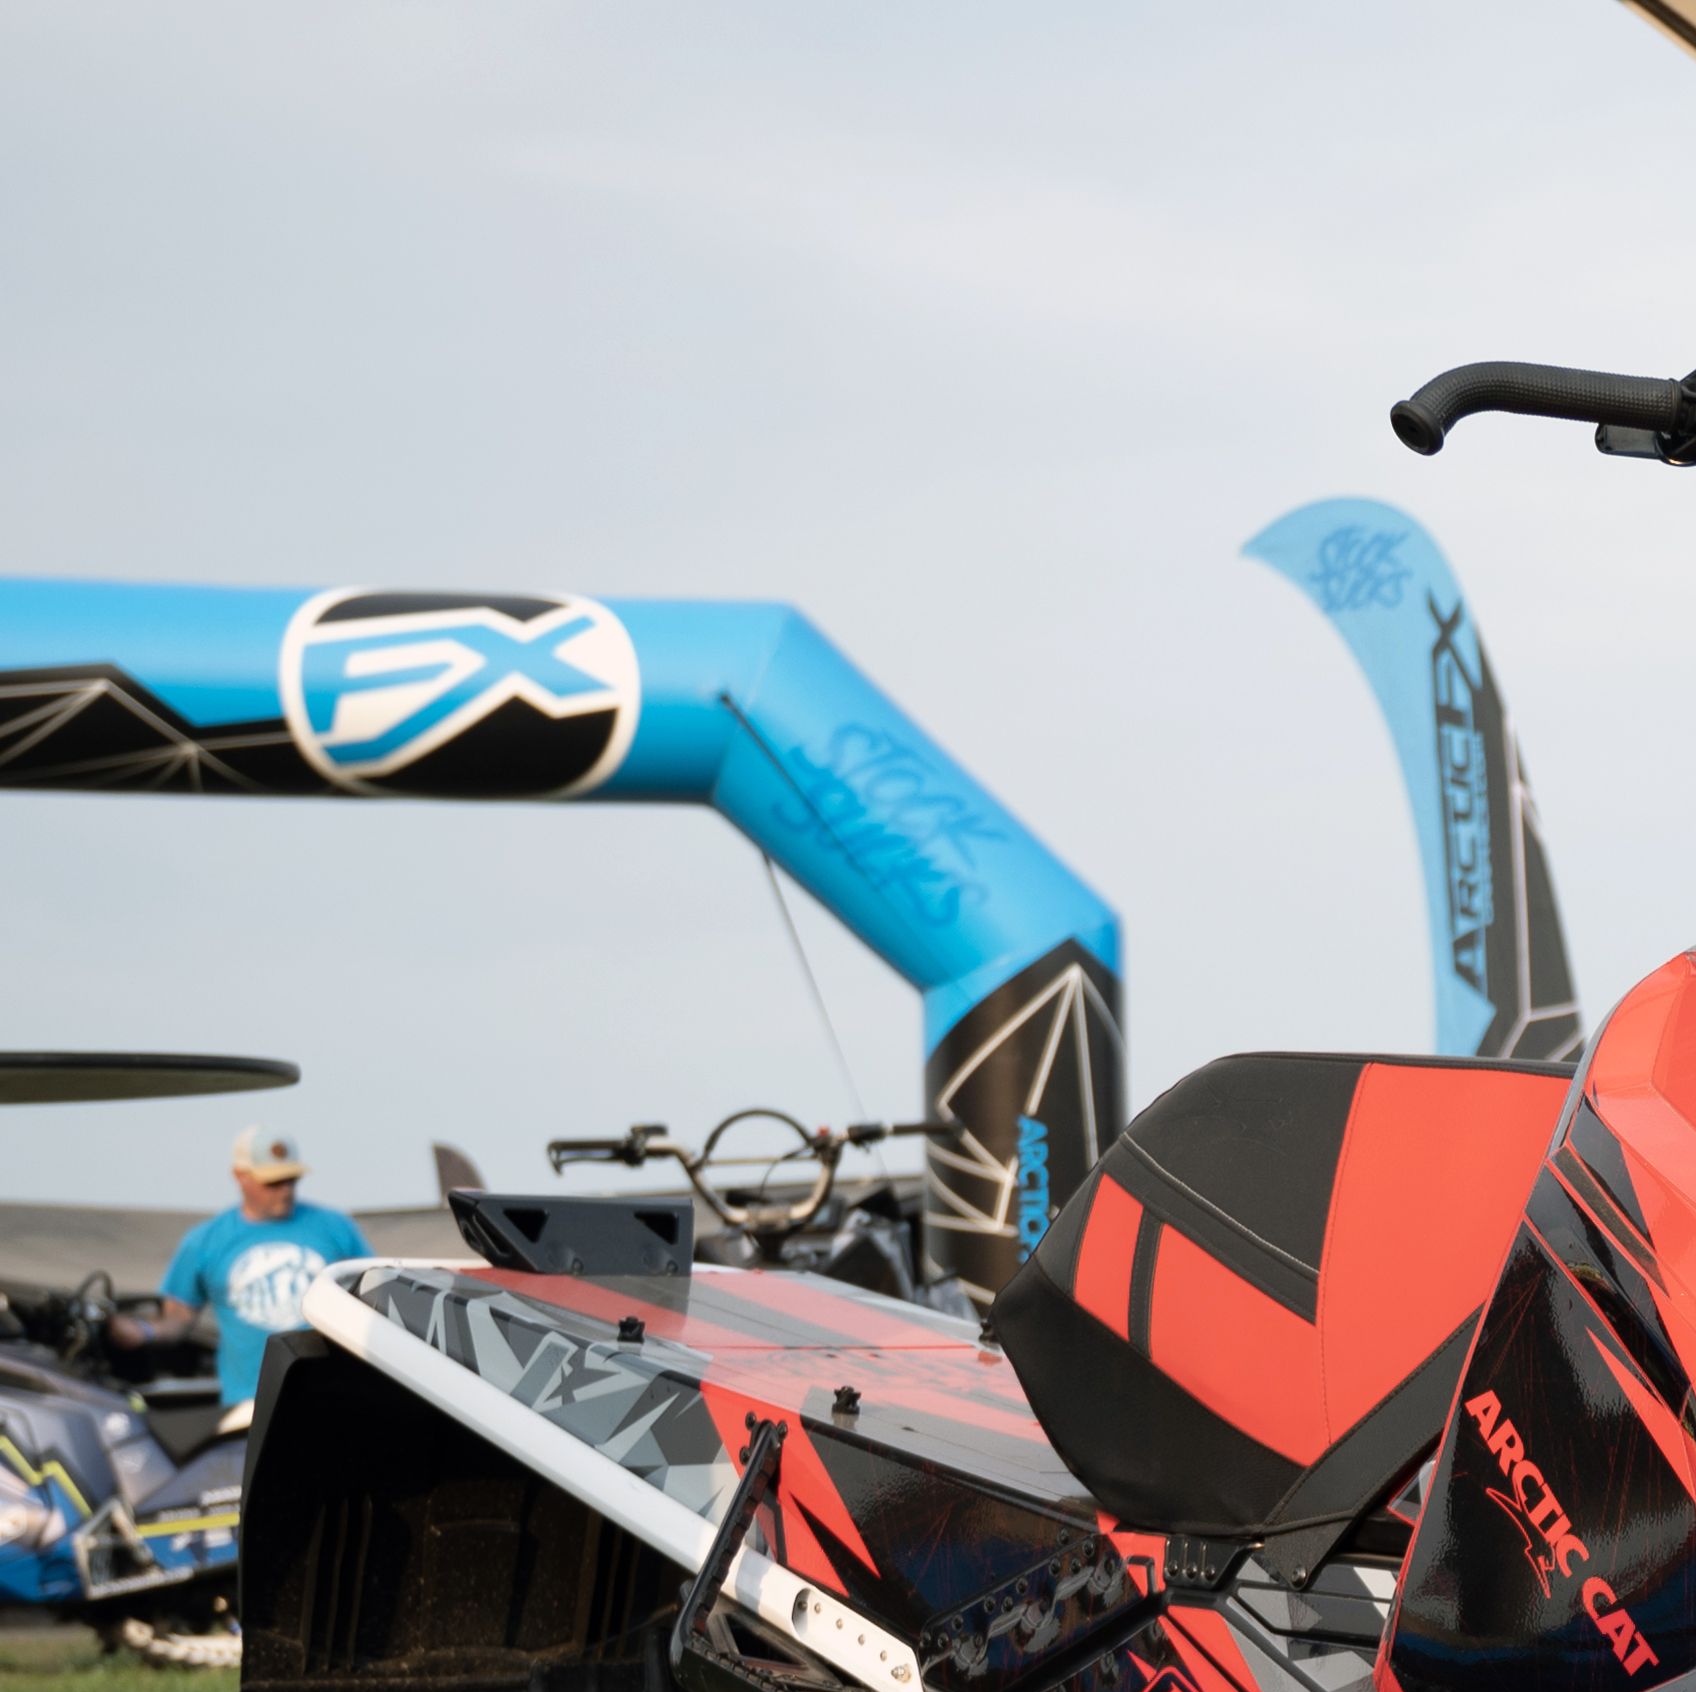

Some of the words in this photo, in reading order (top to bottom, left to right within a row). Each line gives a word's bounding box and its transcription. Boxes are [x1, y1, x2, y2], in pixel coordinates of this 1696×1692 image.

[301, 610, 620, 770] FX
[1427, 588, 1488, 997] ARCTICFX
[1465, 1389, 1590, 1578] ARCTIC
[1581, 1576, 1659, 1676] CAT
